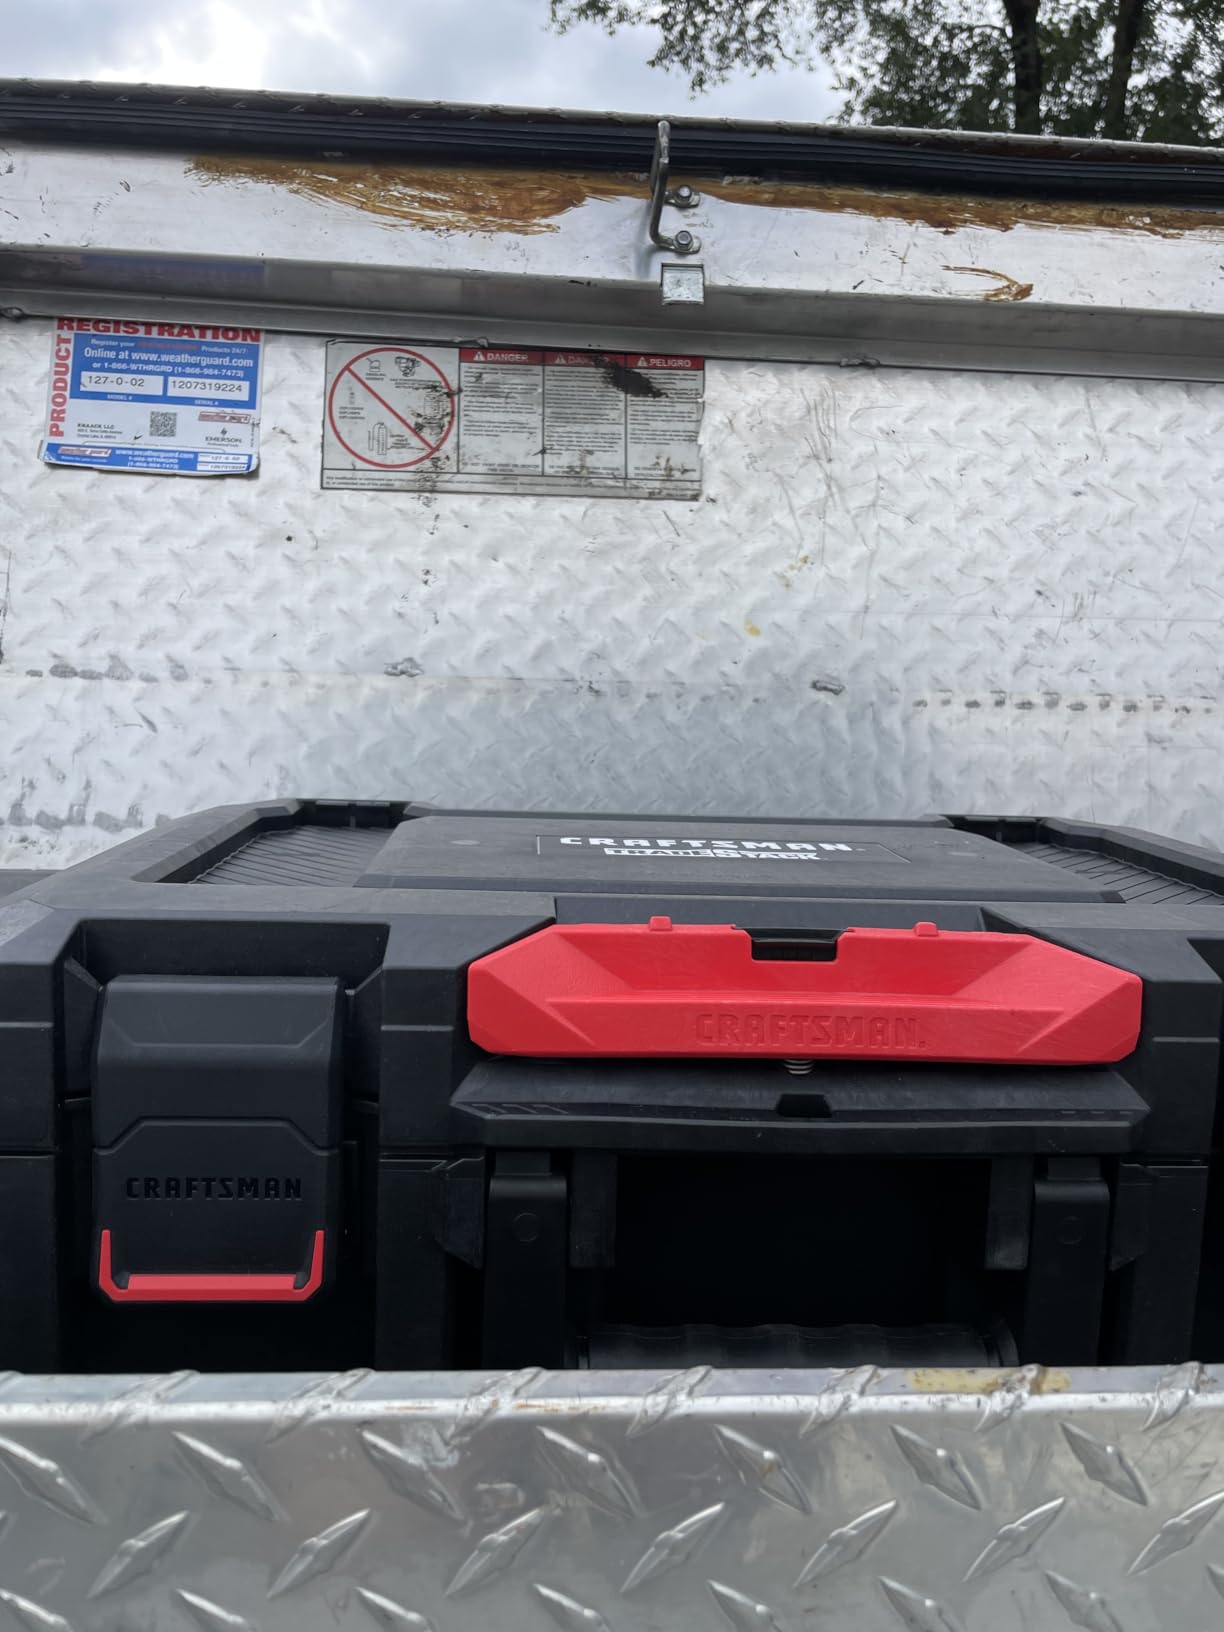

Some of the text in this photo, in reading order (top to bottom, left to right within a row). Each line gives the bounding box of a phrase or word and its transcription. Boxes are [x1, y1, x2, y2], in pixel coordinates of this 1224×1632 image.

[57, 318, 261, 342] REGISTRATION
[84, 347, 254, 367] Online at www.weatherguard.com
[487, 352, 528, 362] DANGER
[650, 358, 692, 368] PELIGRO
[49, 334, 72, 437] PRODUCT
[88, 375, 145, 387] 127-0-02
[171, 380, 242, 393] 1207319224
[560, 837, 853, 851] CRAFTSMAN
[697, 1013, 921, 1049] CRAFTSMAN
[126, 1176, 303, 1201] CRAFTSMAN
